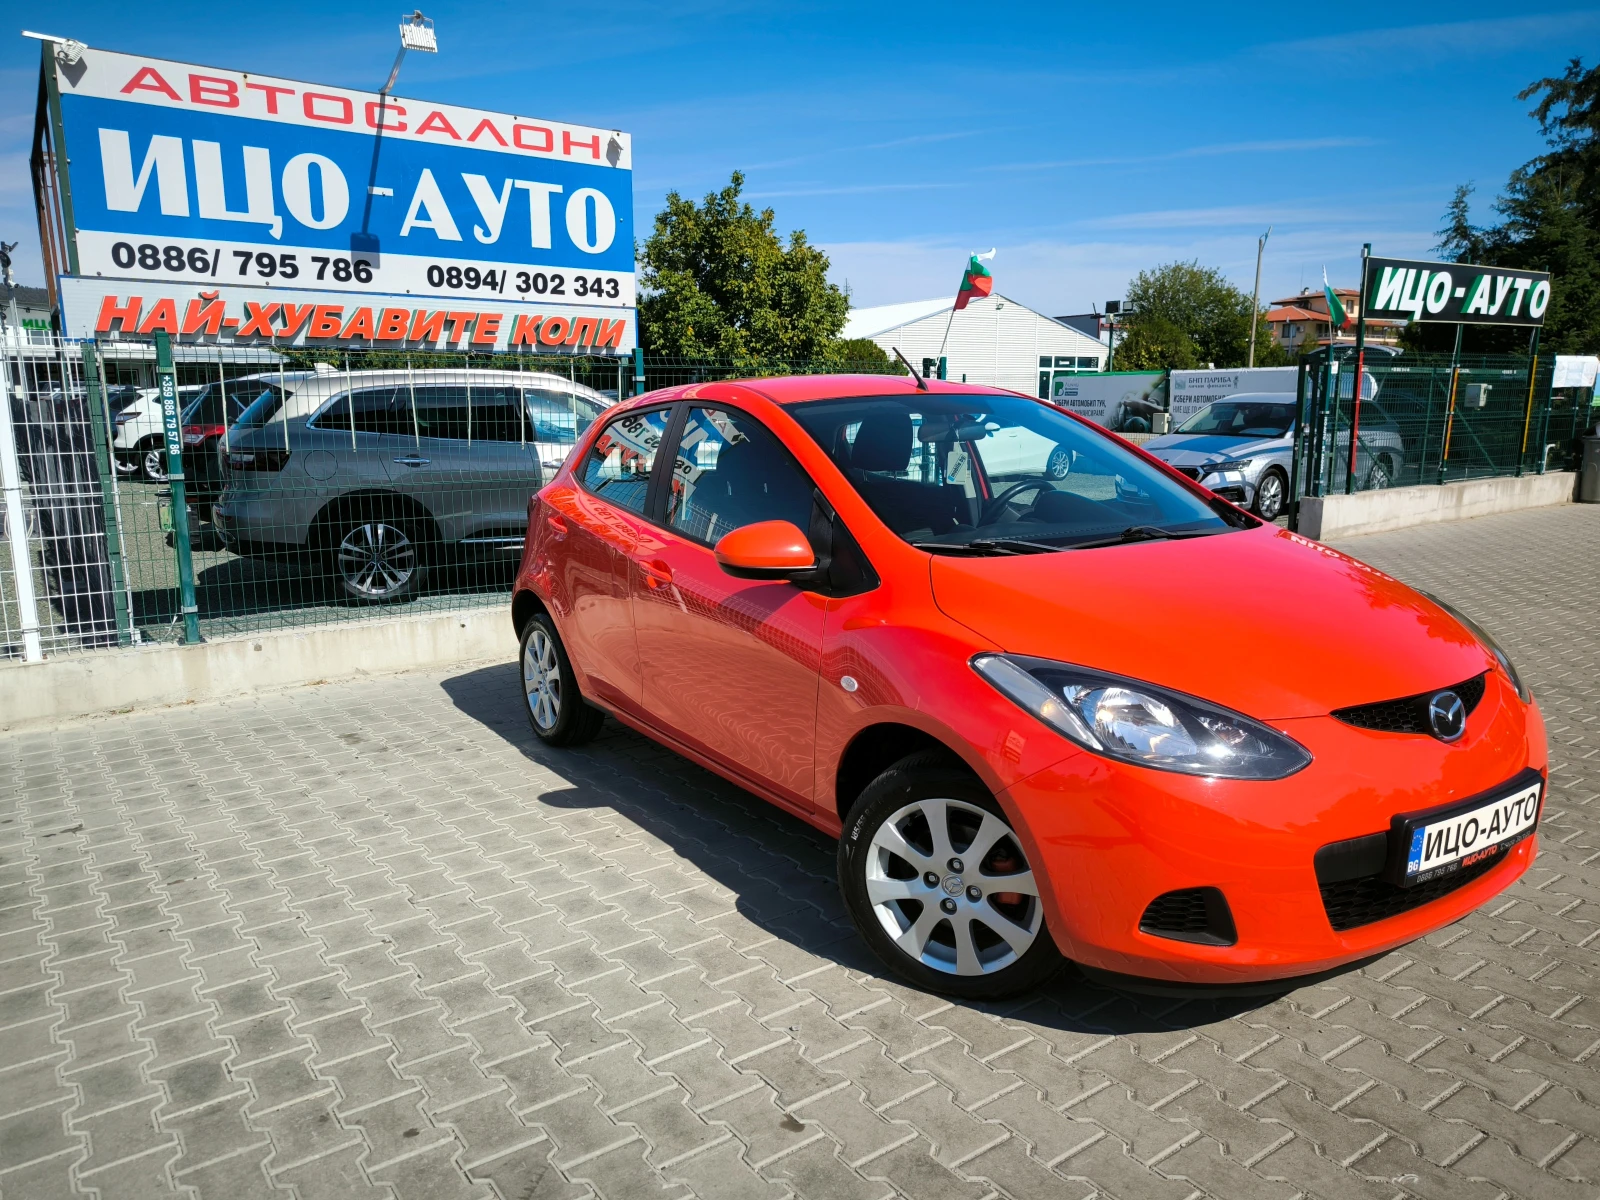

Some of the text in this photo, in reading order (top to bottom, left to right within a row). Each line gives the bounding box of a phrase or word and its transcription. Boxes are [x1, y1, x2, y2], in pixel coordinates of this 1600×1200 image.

[120, 66, 602, 160] АВТОСАЛОН
[111, 241, 374, 284] 0886/ 795 786
[426, 264, 620, 299] 0894/ 302 343
[22, 318, 52, 330] ИЦ
[94, 289, 627, 348] НАЙ-ХУБАВИТЕ КОЛИ
[162, 375, 181, 455] +359 886 79 57 86
[1172, 405, 1182, 413] НИЕ
[1182, 405, 1191, 414] ЩЕ
[1173, 394, 1193, 403] ИЗБЕРИ
[1424, 791, 1537, 863] ИЦО-АУТО
[1407, 859, 1419, 873] BG
